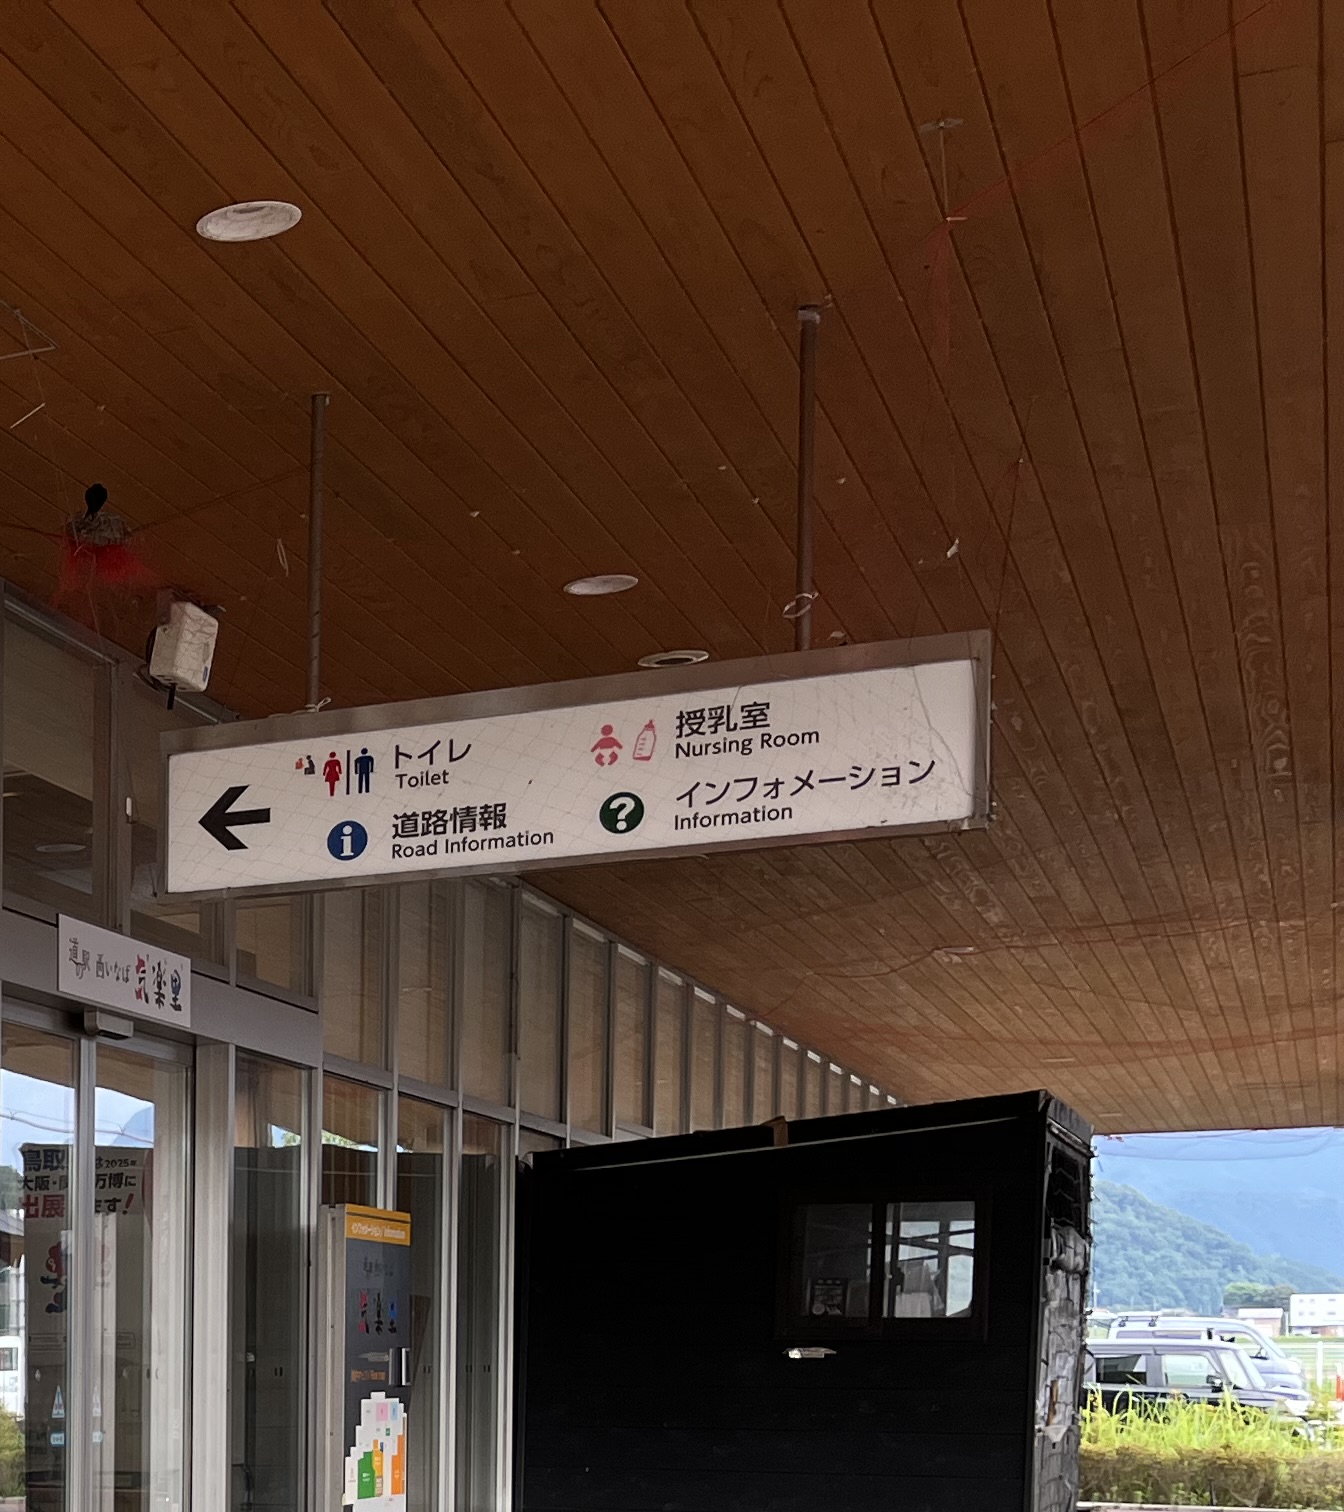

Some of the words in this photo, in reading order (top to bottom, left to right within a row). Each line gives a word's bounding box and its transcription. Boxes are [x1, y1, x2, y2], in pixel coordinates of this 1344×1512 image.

[675, 701, 771, 739] 授乳室
[394, 738, 472, 770] トイレ
[675, 734, 753, 759] Nursing
[760, 730, 820, 749] Room
[394, 769, 450, 789] Toilet
[675, 760, 936, 809] インフォメーション
[391, 803, 508, 840] 道路情報
[674, 806, 793, 831] Information
[391, 840, 438, 859] Road
[445, 831, 554, 854] Information
